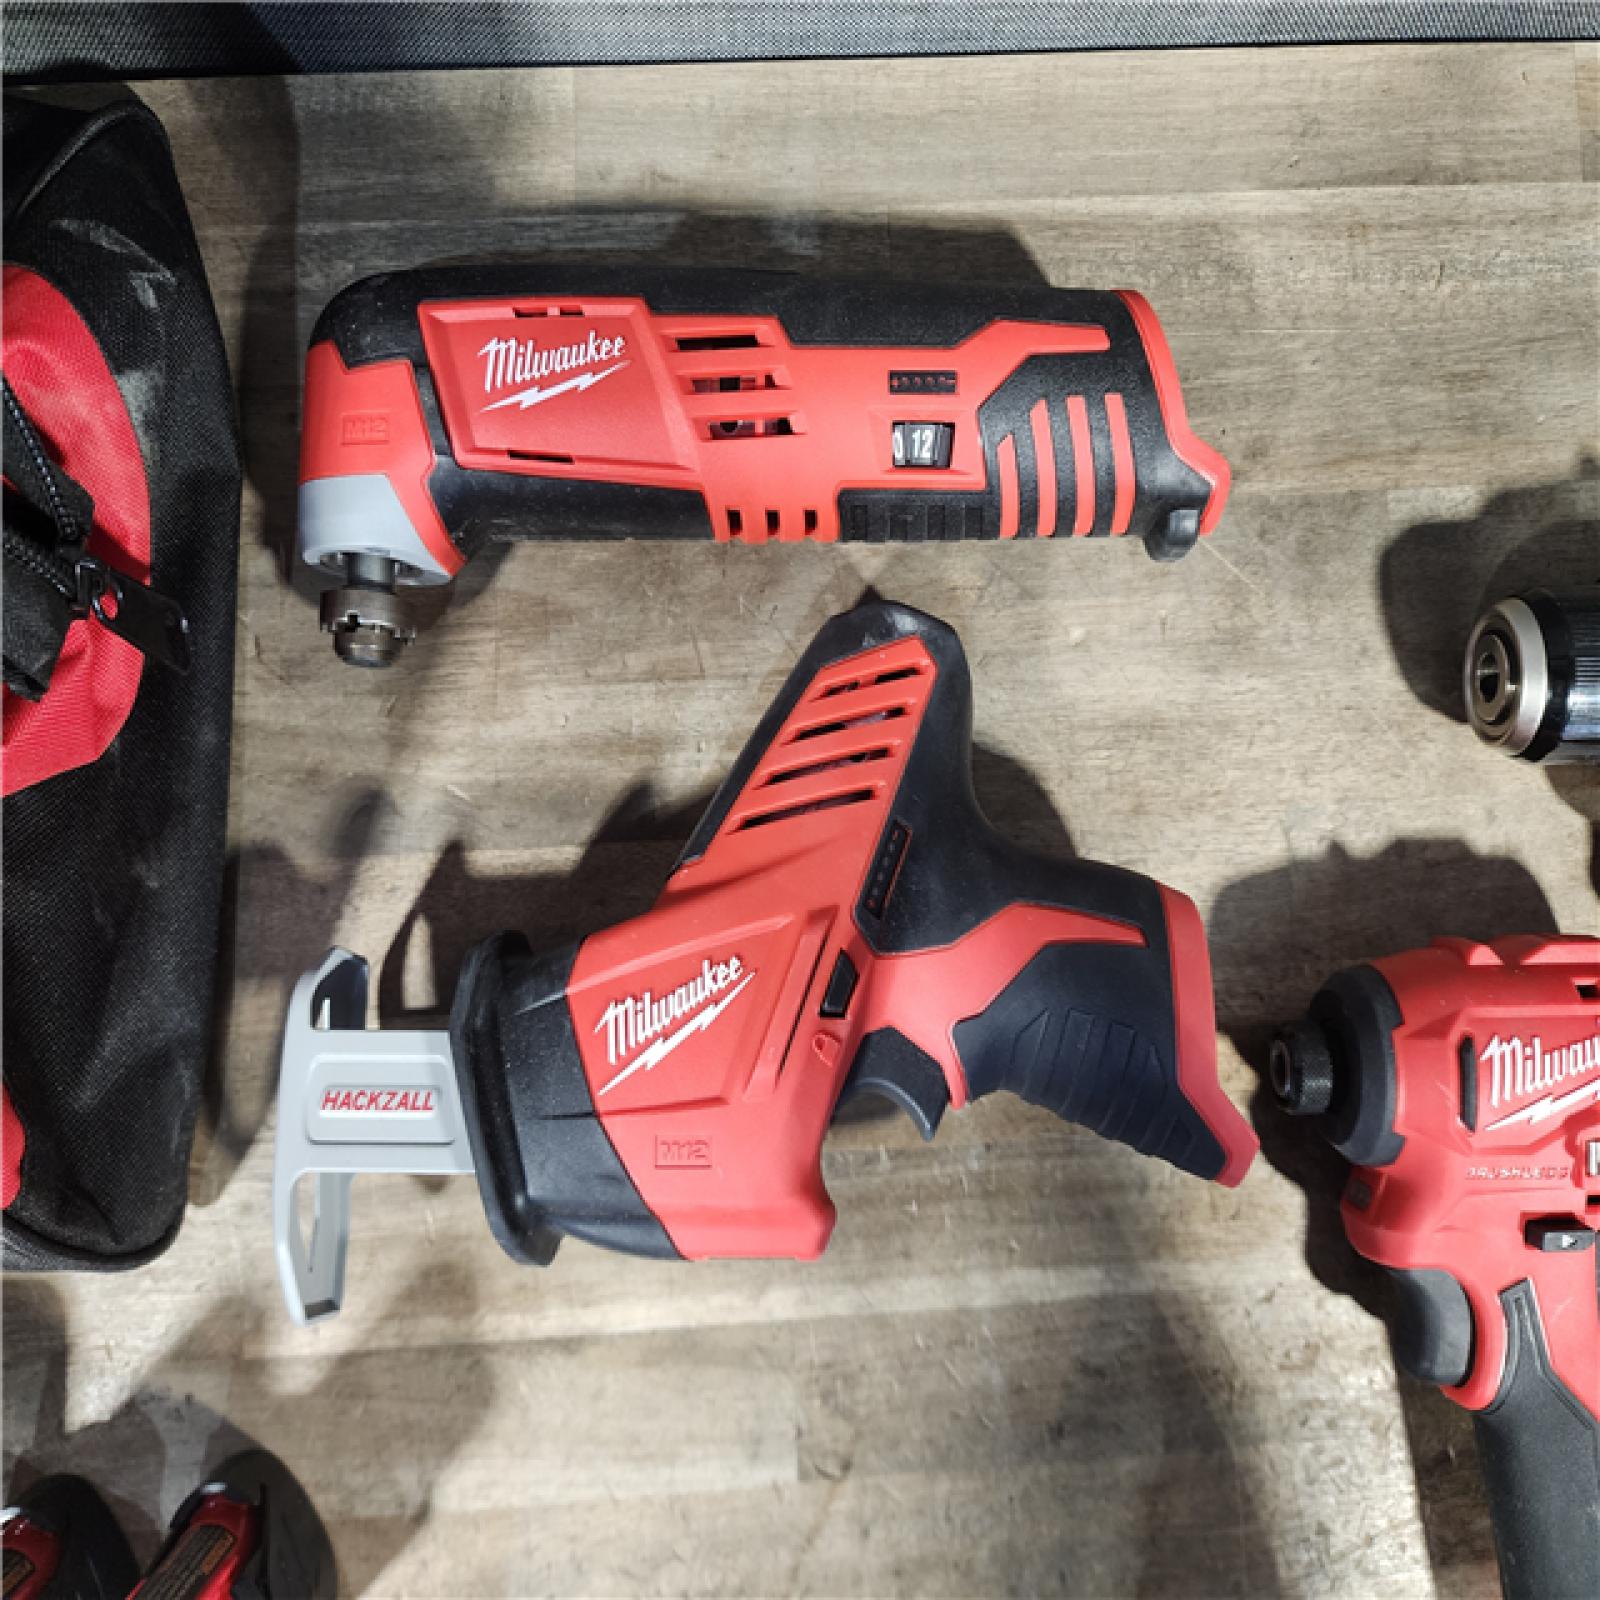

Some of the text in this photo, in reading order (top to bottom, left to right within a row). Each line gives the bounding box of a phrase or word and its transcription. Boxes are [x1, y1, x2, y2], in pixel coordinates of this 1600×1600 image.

[477, 329, 626, 393] Milwaukee
[911, 429, 935, 459] 12
[594, 956, 743, 1065] Milwaukee
[320, 1089, 434, 1111] HACKZALL
